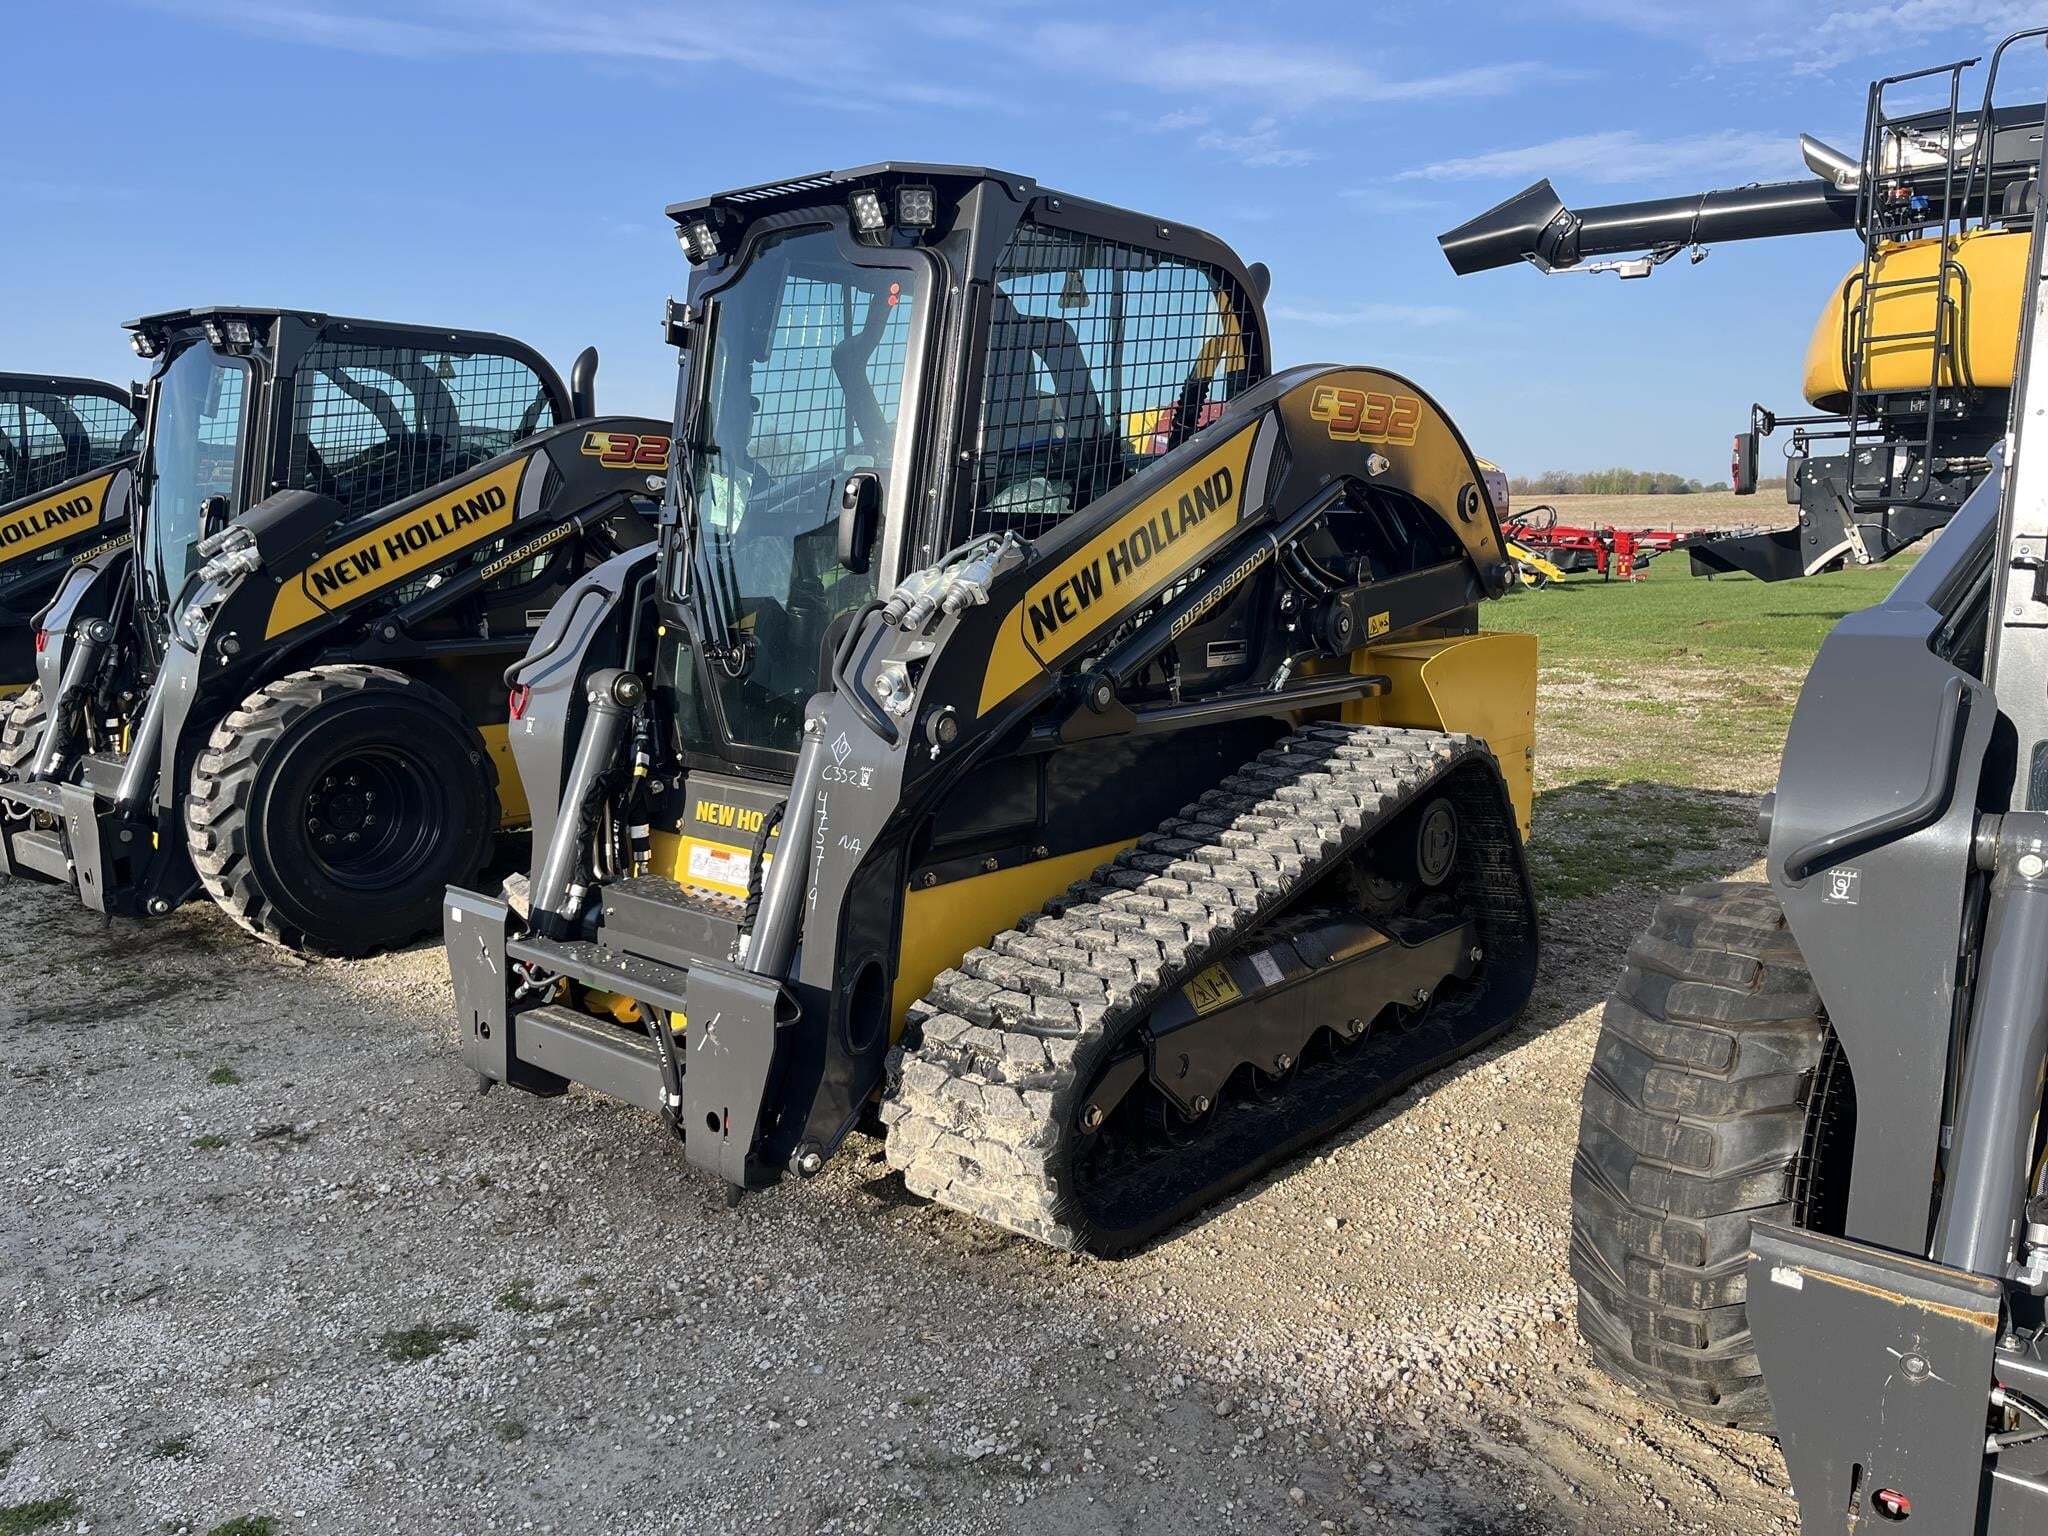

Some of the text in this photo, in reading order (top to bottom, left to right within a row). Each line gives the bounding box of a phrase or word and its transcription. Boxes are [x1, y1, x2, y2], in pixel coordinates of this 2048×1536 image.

[581, 432, 672, 470] L32
[72, 540, 117, 564] SUPER
[310, 485, 507, 596] NEW HOLLAND
[480, 521, 572, 580] SUPER BOOM
[1027, 465, 1234, 644] NEW HOLLAND
[1170, 547, 1267, 640] SUPER BOOM
[822, 765, 858, 785] C332
[696, 800, 735, 827] NEW
[838, 834, 862, 855] NA
